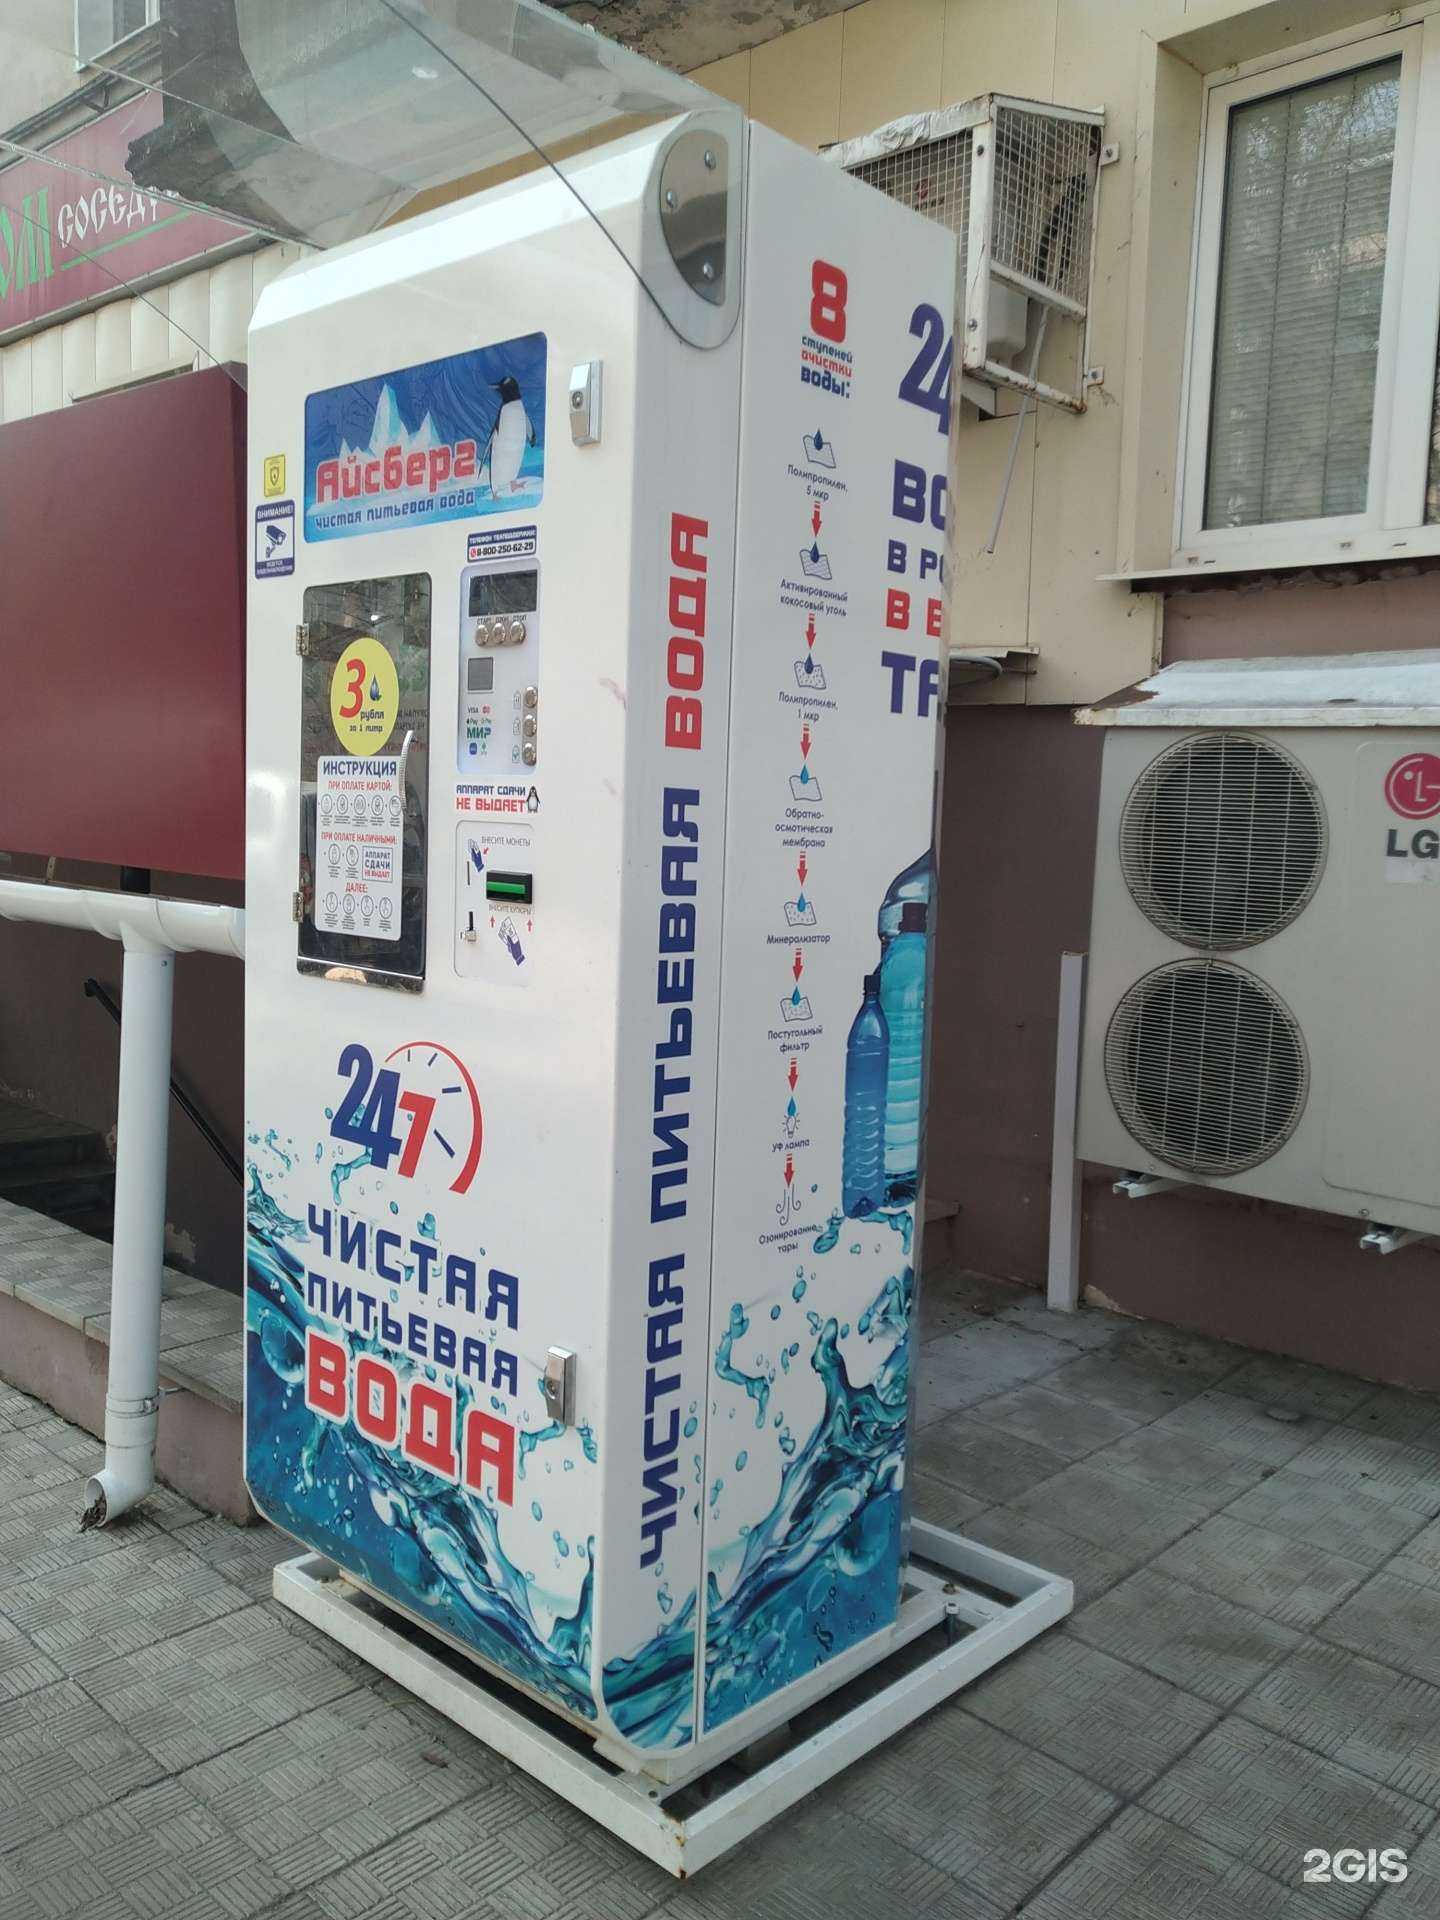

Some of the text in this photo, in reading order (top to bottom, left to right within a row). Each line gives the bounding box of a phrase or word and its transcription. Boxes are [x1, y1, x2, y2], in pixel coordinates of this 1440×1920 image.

[810, 260, 848, 343] 8
[801, 336, 852, 364] ступеней
[801, 350, 852, 377] очистки
[801, 365, 850, 399] воды:
[317, 441, 476, 504] Айсберг
[787, 464, 848, 493] Полипропилен,
[806, 485, 829, 502] 5 мкр
[315, 489, 475, 529] чистая питьевая вода
[887, 539, 907, 574] В
[780, 578, 848, 602] Активированный
[780, 595, 847, 617] кокосовый уголь
[886, 588, 911, 630] В
[338, 658, 366, 719] 3
[779, 691, 839, 711] Полипропилен,
[803, 712, 820, 724] мкр
[466, 726, 492, 739] МИР
[323, 760, 397, 778] ИНСТРУКЦИЯ
[327, 780, 392, 791] ПРИ ОПЛАТЕ КАРТОЙ:
[456, 784, 526, 796] АППАРАТ СДАЧИ
[456, 797, 526, 813] НЕ ВЫДАЕТ
[785, 808, 824, 820] Обратно-
[334, 832, 356, 842] ОПЛАТЕ
[775, 823, 833, 834] осмотическая
[782, 837, 826, 848] мембрана
[1386, 829, 1440, 859] LG
[365, 860, 391, 869] СДАЧИ
[345, 882, 368, 894] ДАЛЕЕ:
[767, 934, 831, 946] Минерализатор
[640, 512, 709, 1569] ЧИСТАЯ ПИТЬЕВАЯ ВОДА
[768, 1025, 823, 1040] Постугольный
[779, 1041, 810, 1053] фильтр
[784, 1138, 810, 1150] лампа
[759, 1224, 817, 1245] Озонирование
[778, 1242, 799, 1254] тары
[307, 1202, 519, 1332] ЧИСТАЯ
[307, 1271, 518, 1397] ПИТЬЕВАЯ
[307, 1332, 515, 1508] ВОДА
